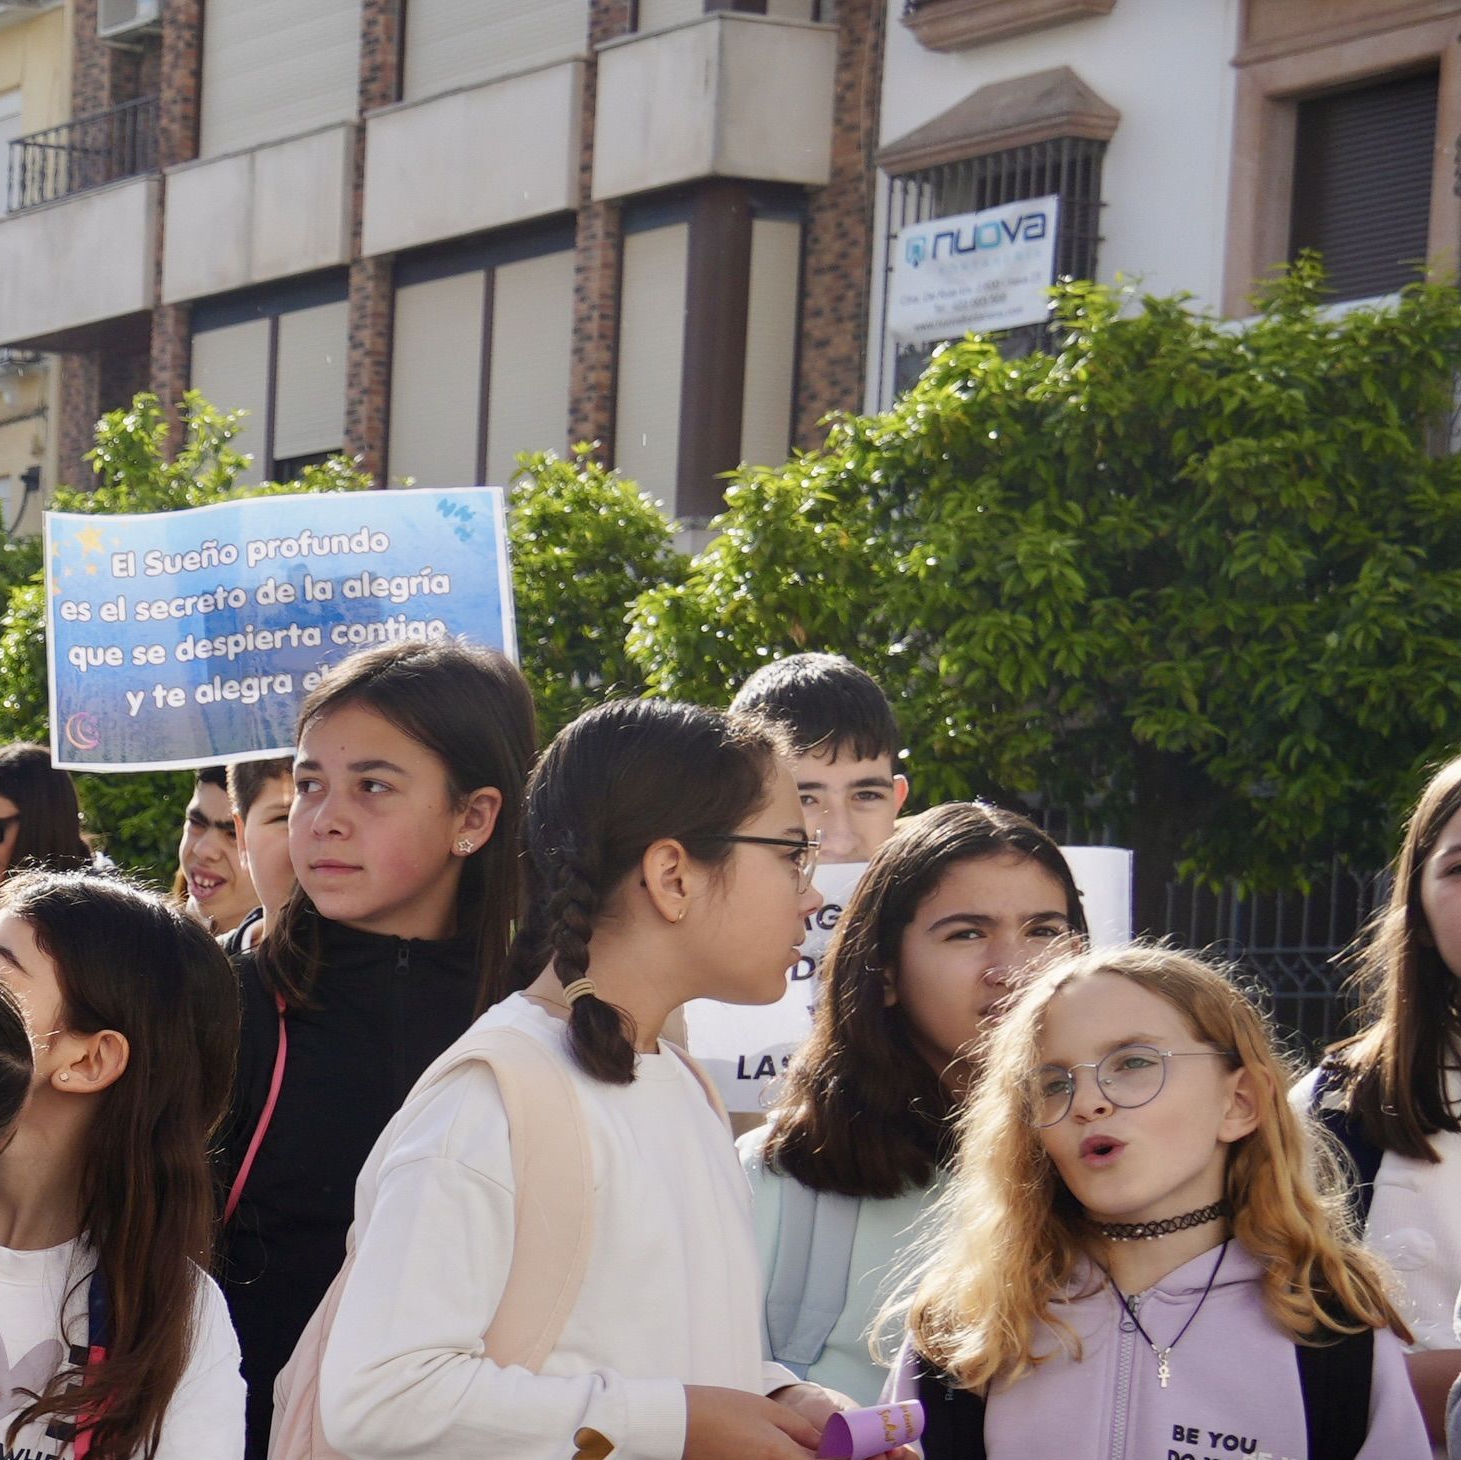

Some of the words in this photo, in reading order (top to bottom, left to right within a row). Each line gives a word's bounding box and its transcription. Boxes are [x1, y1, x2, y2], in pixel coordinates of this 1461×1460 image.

[932, 213, 1046, 259] nuova
[111, 551, 136, 579] El
[144, 538, 238, 577] Sueño
[246, 526, 390, 569] profundo
[60, 599, 91, 622] es
[99, 595, 127, 623] el
[134, 586, 246, 621] secreto
[255, 577, 296, 607] de
[304, 574, 333, 603] la
[342, 566, 451, 602] alegría
[68, 644, 123, 673] que
[131, 643, 166, 667] se
[175, 623, 321, 662] despierta
[125, 689, 145, 718] y
[152, 683, 186, 710] te
[194, 672, 293, 707] alegra
[1173, 1425, 1199, 1445] BE
[1208, 1432, 1257, 1454] YOU
